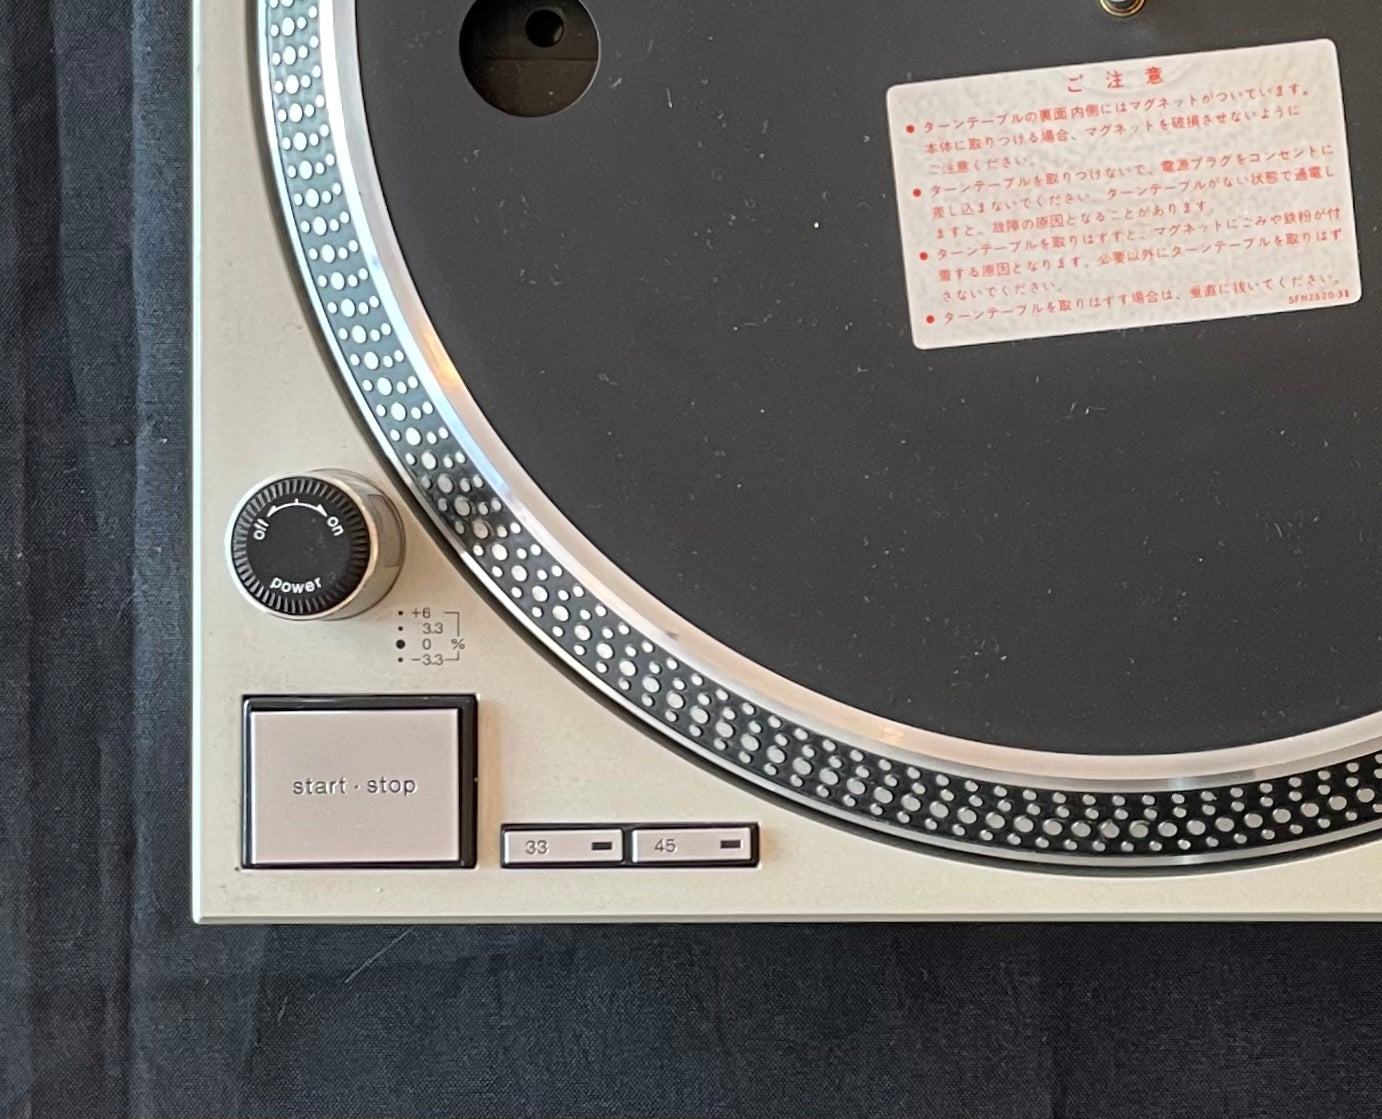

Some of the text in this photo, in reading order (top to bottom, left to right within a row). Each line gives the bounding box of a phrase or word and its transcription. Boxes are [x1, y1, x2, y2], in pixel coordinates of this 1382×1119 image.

[253, 518, 270, 541] off
[327, 517, 344, 537] on
[270, 576, 322, 594] power
[411, 608, 431, 619] +6
[422, 623, 444, 634] 3.3
[421, 639, 431, 650] 0
[292, 776, 417, 797] start stop
[525, 839, 550, 855] 33
[654, 838, 677, 853] 45
